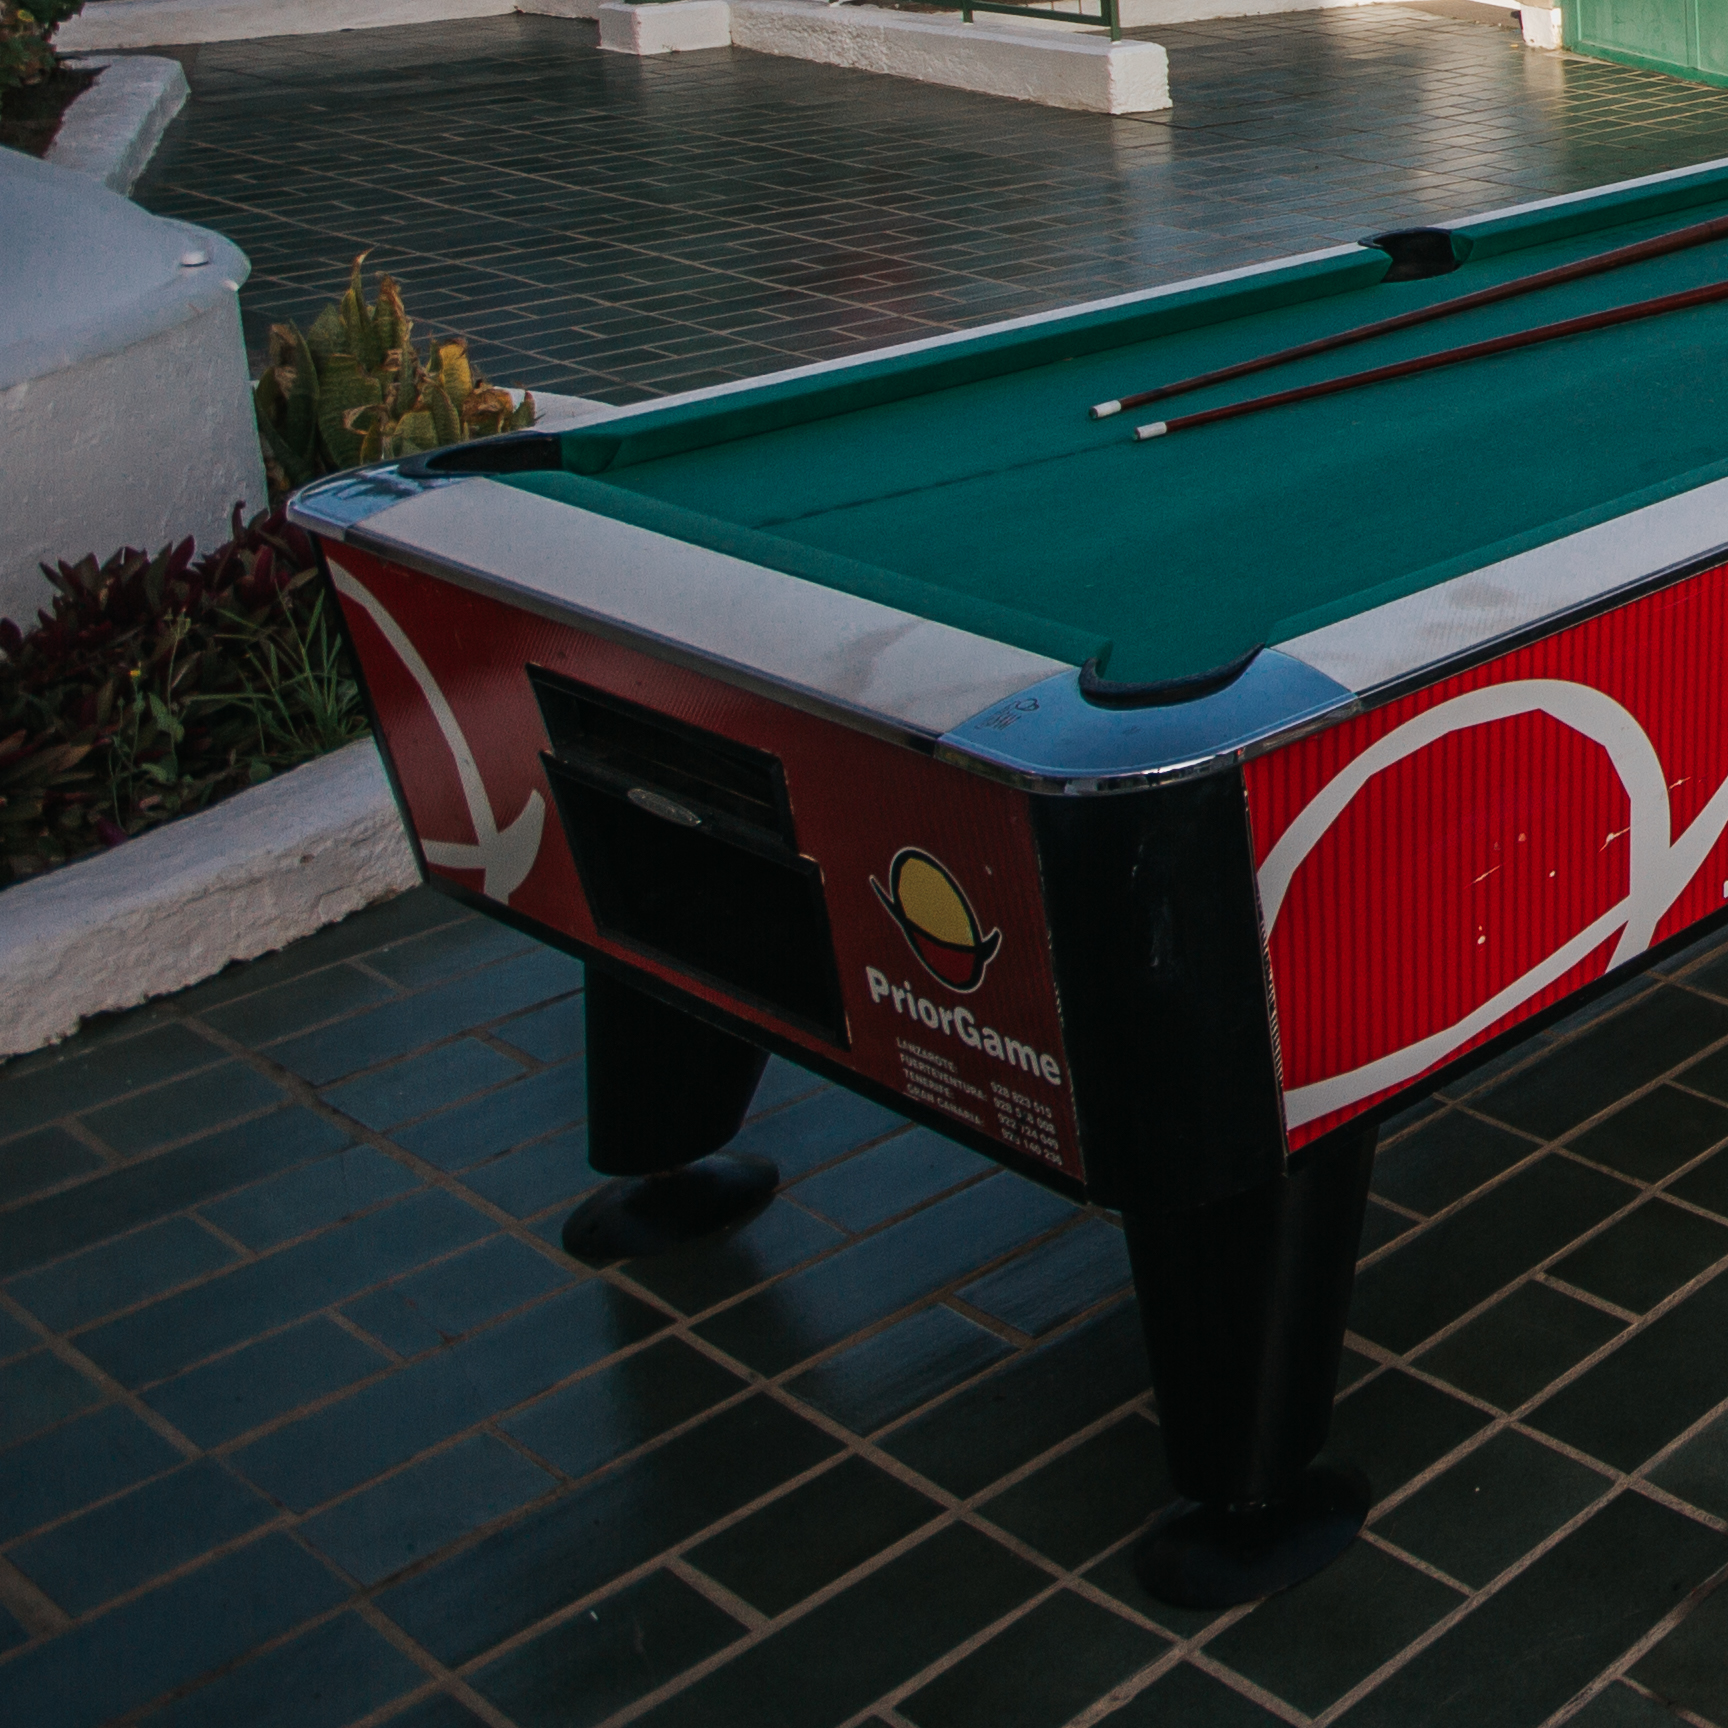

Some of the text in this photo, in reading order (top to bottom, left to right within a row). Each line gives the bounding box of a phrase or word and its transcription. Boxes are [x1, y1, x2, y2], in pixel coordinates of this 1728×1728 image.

[866, 965, 1062, 1086] PriorGame
[990, 1081, 1010, 1098] 928
[1012, 1090, 1031, 1109] 823
[1033, 1101, 1052, 1119] 515
[1015, 1107, 1034, 1124] 58
